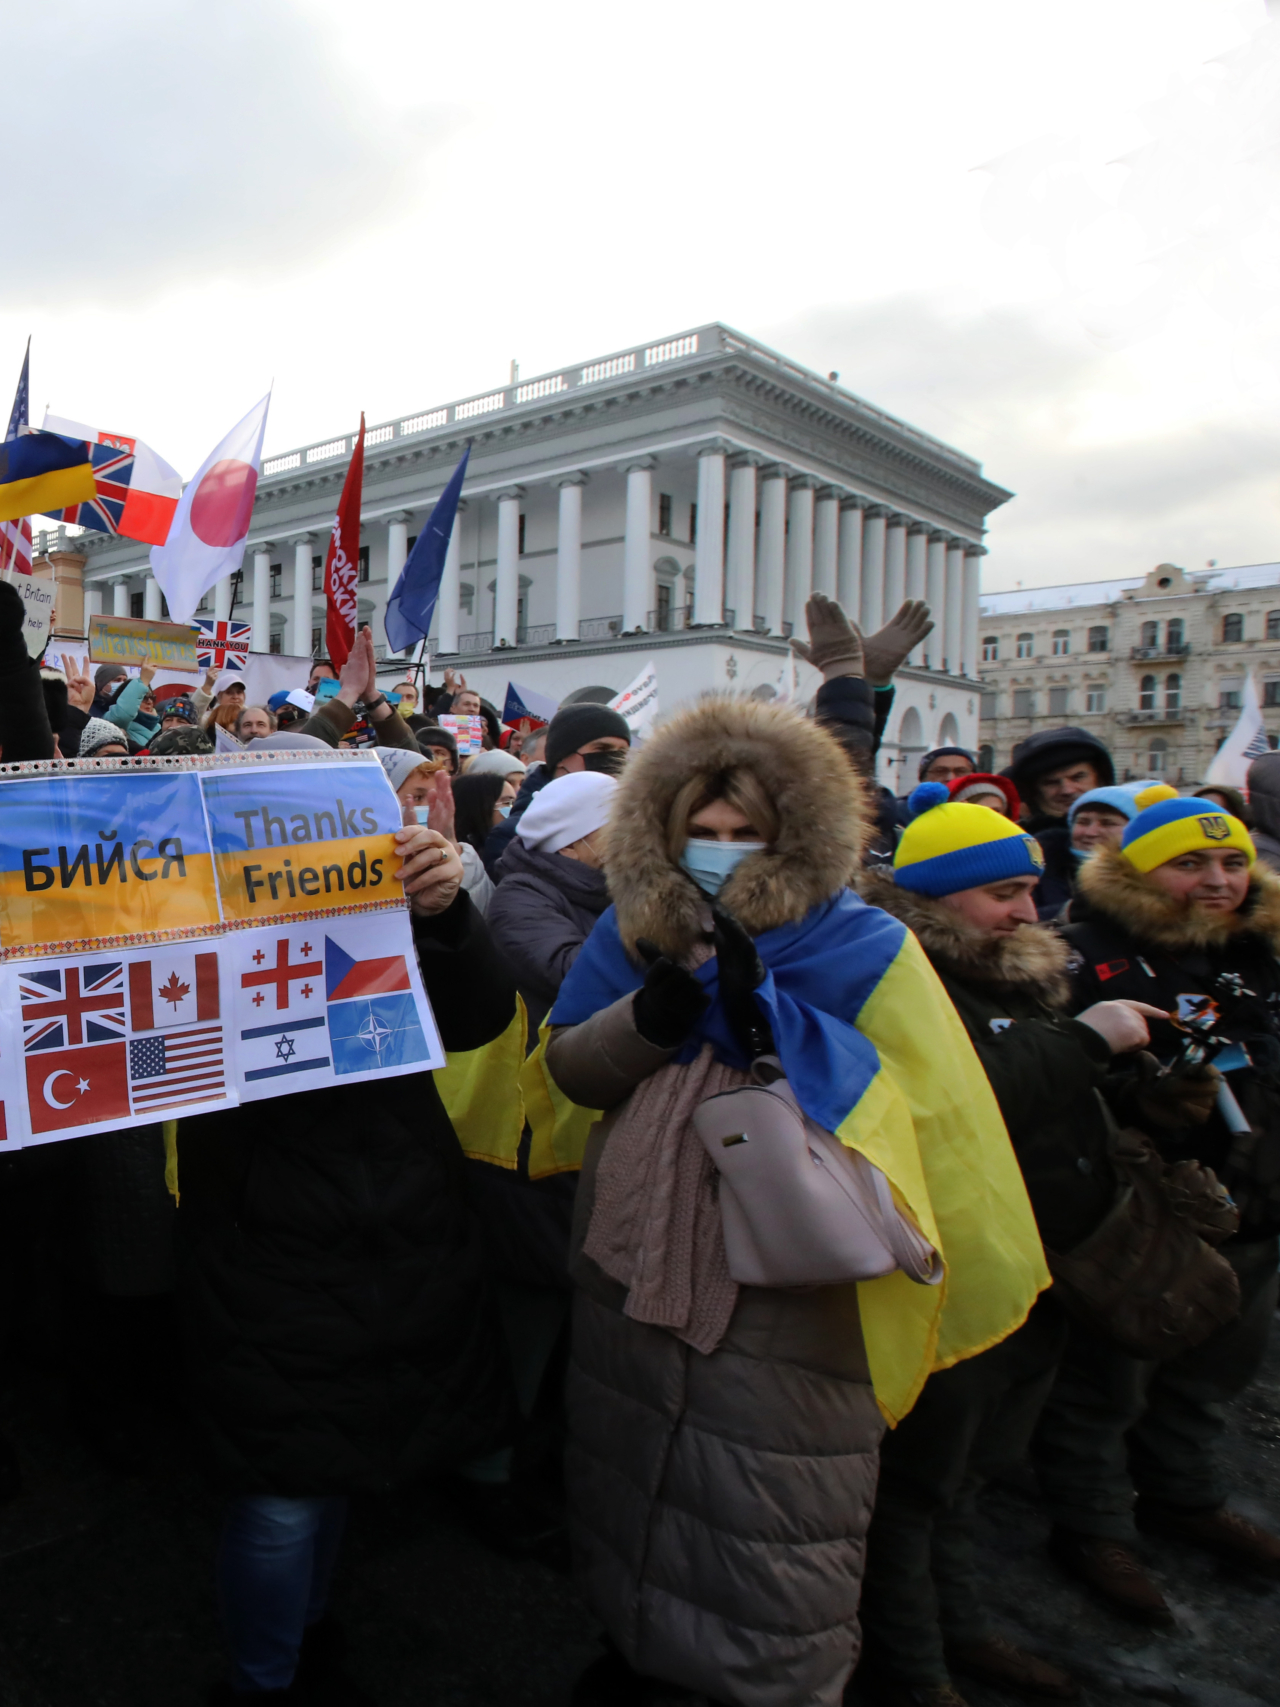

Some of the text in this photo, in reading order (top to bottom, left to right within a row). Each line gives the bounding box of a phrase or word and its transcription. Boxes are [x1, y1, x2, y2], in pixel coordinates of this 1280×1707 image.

[24, 583, 51, 604] Britain
[28, 617, 43, 630] help
[229, 642, 246, 651] YOU
[234, 799, 378, 848] Thanks
[22, 829, 187, 892] БИЙСЯ
[243, 850, 383, 903] Friends
